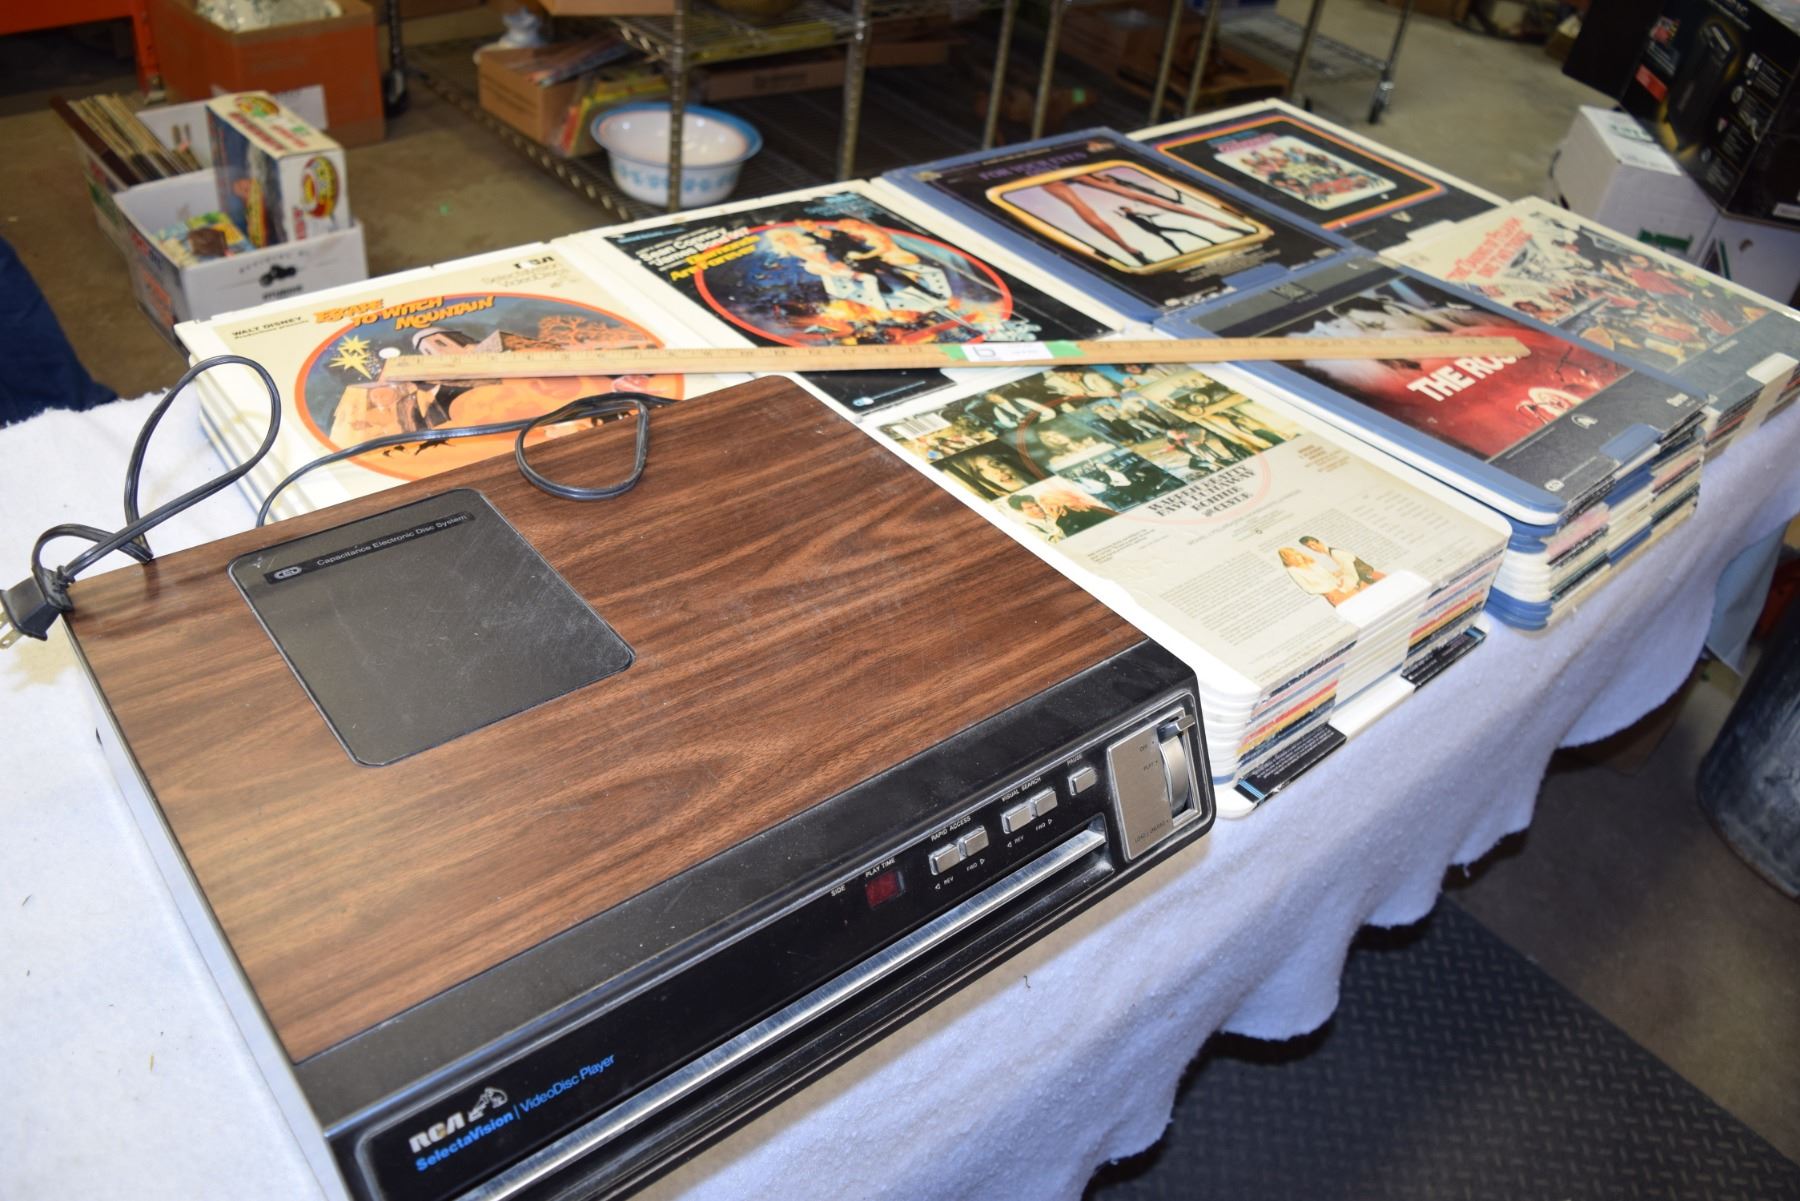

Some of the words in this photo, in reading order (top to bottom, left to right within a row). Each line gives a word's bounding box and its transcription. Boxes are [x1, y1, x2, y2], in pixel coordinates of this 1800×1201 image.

[351, 314, 379, 328] TO
[382, 296, 444, 320] WITCH
[396, 296, 495, 330] MOUNTAIN
[232, 325, 260, 337] WALT
[263, 316, 302, 330] DISNEY
[1406, 365, 1477, 402] THE
[1454, 356, 1521, 380] RO
[316, 544, 371, 566] Capacitance
[373, 531, 415, 549] Electronic
[416, 524, 435, 535] Disc
[436, 514, 467, 528] System
[1066, 754, 1083, 766] PAUSE
[1001, 789, 1020, 802] VISUAL
[1021, 777, 1042, 791] SEARCH
[930, 828, 949, 842] RAPID
[949, 815, 972, 831] ACCESS
[865, 866, 881, 878] PLAY
[881, 857, 897, 869] TIME
[943, 876, 954, 886] REV
[830, 884, 847, 897] SIDE
[415, 1110, 514, 1173] SelectaVision
[519, 1072, 580, 1115] VideoDisc
[578, 1054, 616, 1082] Player
[408, 1111, 465, 1153] RCA
